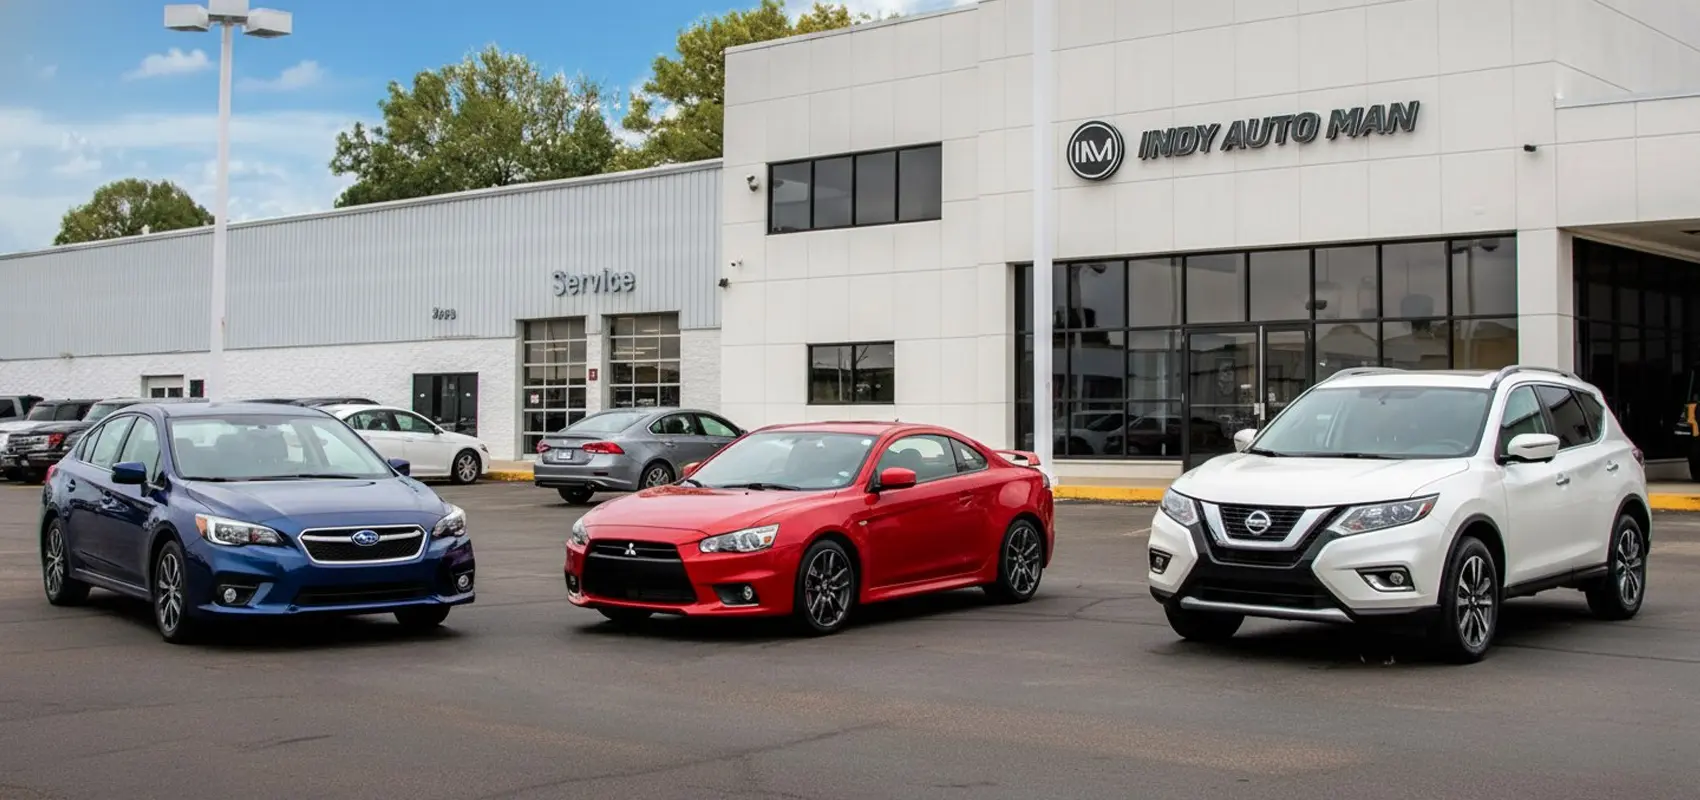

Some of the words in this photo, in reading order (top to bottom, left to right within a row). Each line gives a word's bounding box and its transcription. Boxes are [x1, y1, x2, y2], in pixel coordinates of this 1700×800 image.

[1138, 122, 1219, 160] INDY
[1220, 112, 1321, 152] AUTO
[1326, 100, 1420, 141] MAN
[552, 268, 636, 297] Service
